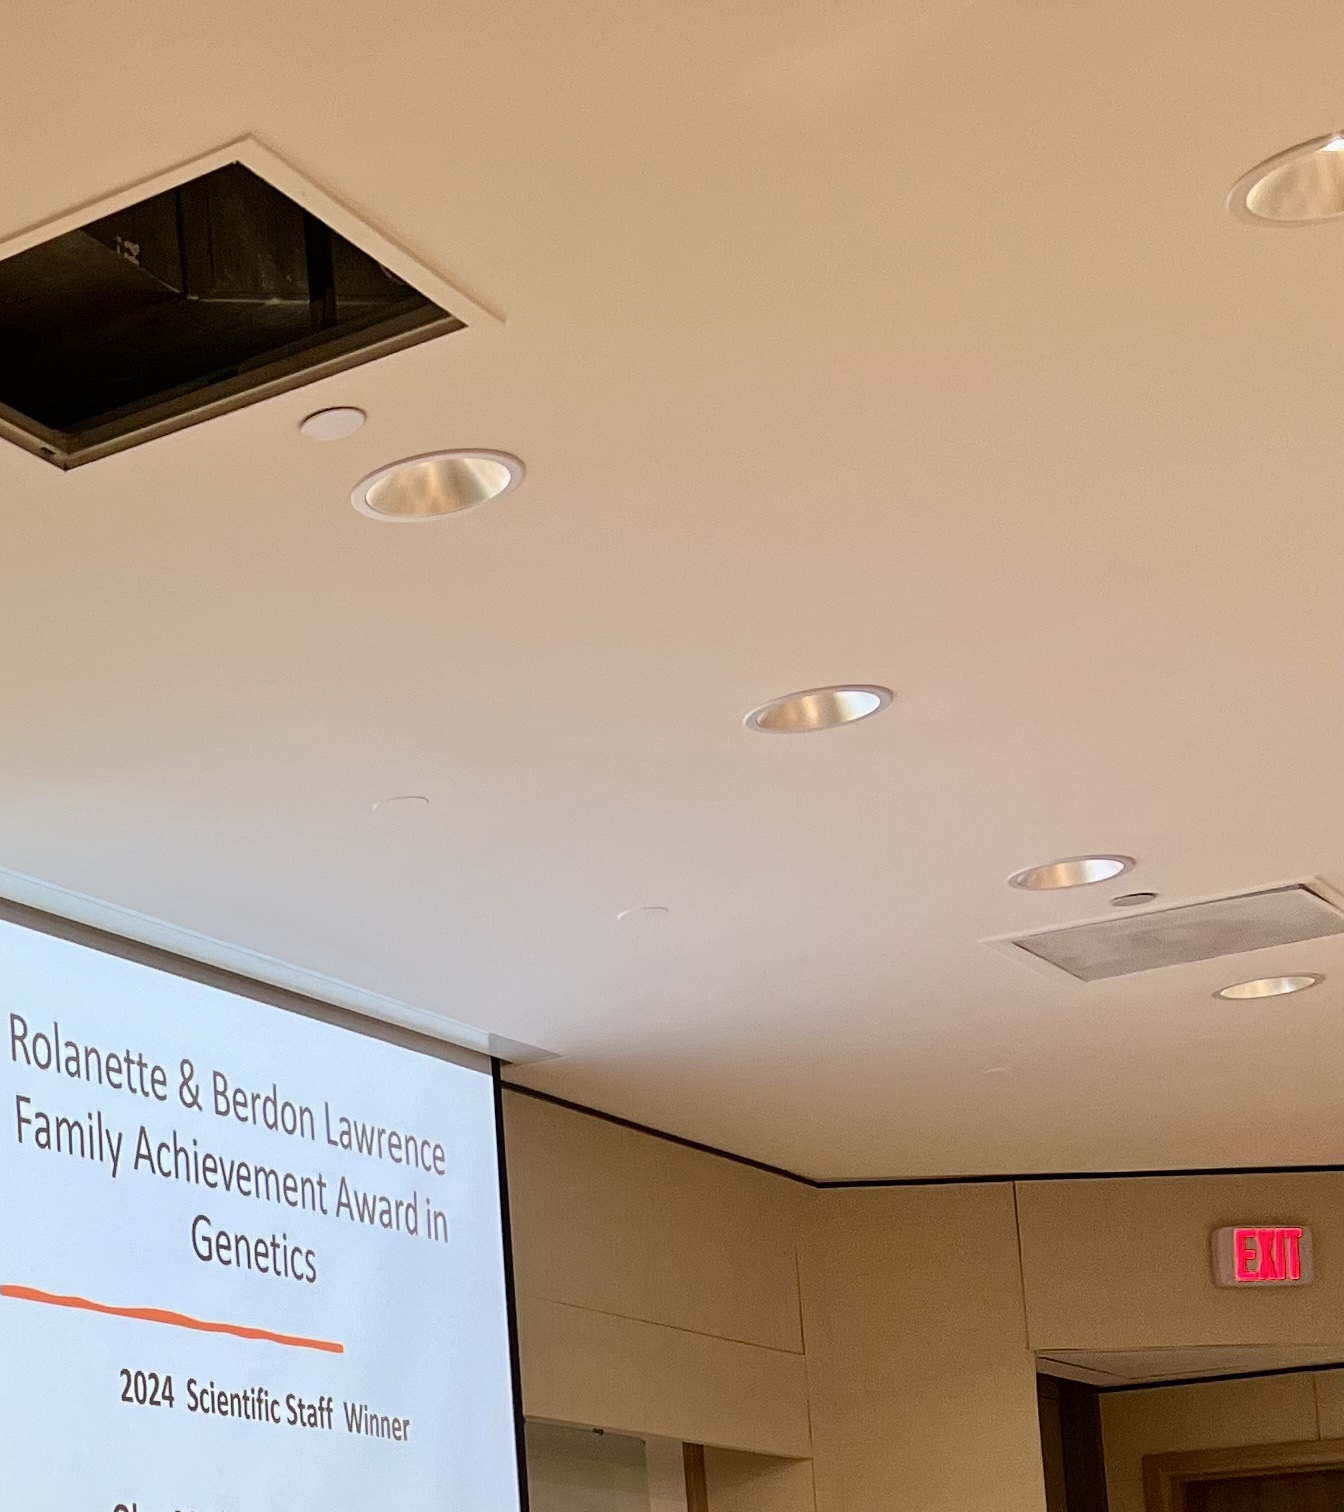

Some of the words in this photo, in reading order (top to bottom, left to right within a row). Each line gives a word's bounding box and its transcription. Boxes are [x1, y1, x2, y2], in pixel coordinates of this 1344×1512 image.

[10, 1013, 167, 1101] Rolanette
[179, 1059, 202, 1112] &
[213, 1070, 315, 1140] Berdon
[325, 1102, 445, 1175] Lawrence
[16, 1095, 122, 1178] Family
[134, 1126, 327, 1215] Achievement
[336, 1177, 418, 1236] Award
[426, 1198, 448, 1243] in
[192, 1215, 316, 1283] Genetics
[1234, 1227, 1303, 1282] EXIT
[120, 1369, 174, 1408] 2024
[187, 1378, 280, 1423] Scientific
[286, 1394, 333, 1429] Staff
[343, 1402, 410, 1441] Winner
